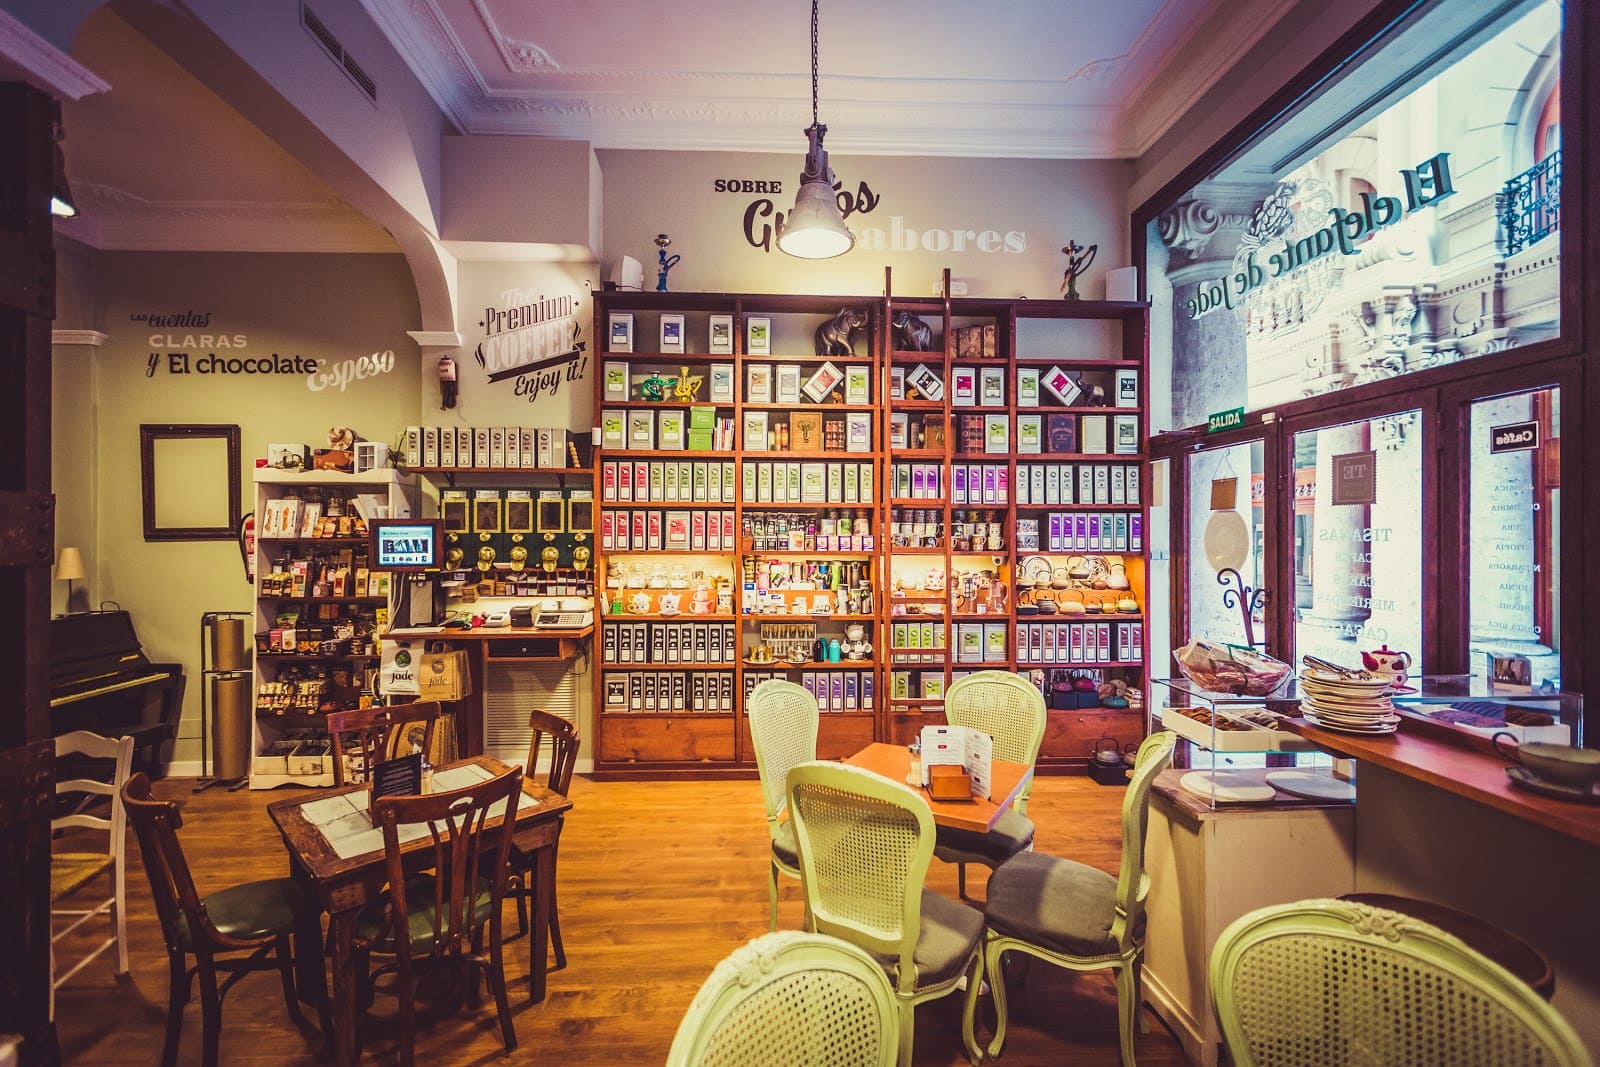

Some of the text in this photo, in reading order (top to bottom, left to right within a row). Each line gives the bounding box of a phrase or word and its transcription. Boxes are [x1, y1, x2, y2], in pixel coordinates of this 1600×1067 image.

[714, 179, 782, 194] SOBRE
[743, 180, 880, 252] Guos
[859, 215, 1026, 253] abores
[148, 310, 211, 328] cuentas
[485, 294, 572, 336] Premium
[149, 334, 247, 348] CLARAS
[486, 320, 573, 371] COFFEE
[146, 350, 395, 392] y El chocolate Espeso
[514, 356, 588, 403] Enjoy it!
[1210, 412, 1241, 429] SALIDA
[390, 669, 414, 684] jade
